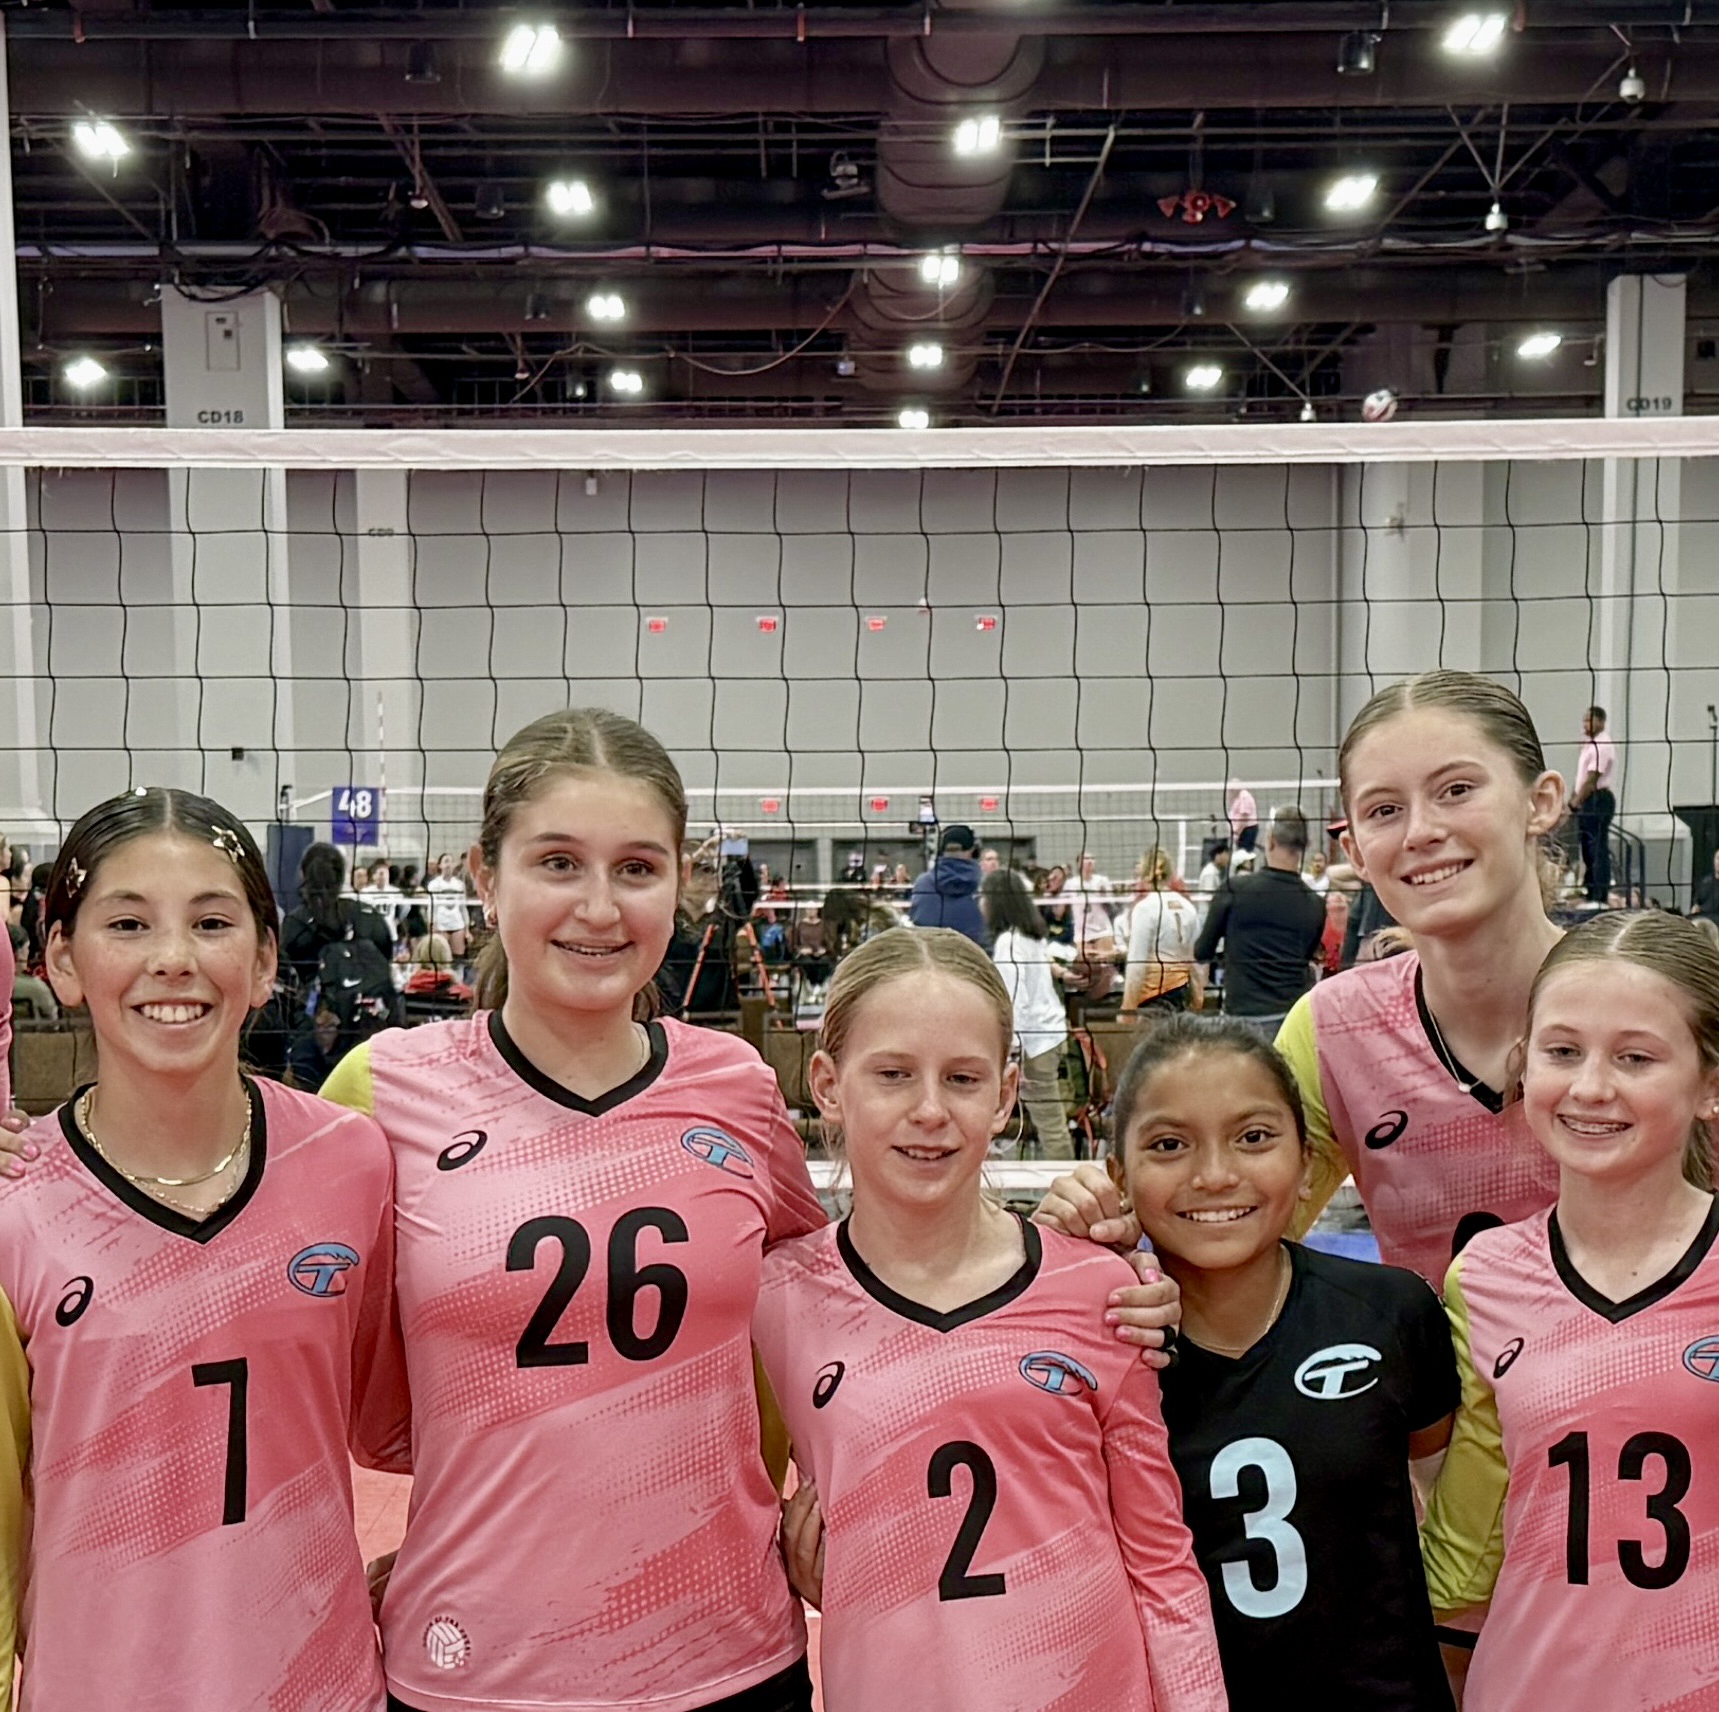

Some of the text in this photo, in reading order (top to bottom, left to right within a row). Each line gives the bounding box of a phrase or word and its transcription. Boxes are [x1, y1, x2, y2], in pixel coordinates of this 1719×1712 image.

[197, 410, 244, 424] CD18
[1626, 397, 1672, 411] CD19
[337, 789, 372, 819] 48
[505, 1206, 689, 1369] 26
[192, 1357, 248, 1526] 7
[927, 1441, 1006, 1602] 2
[1548, 1431, 1692, 1590] 13
[1209, 1437, 1309, 1618] 3
